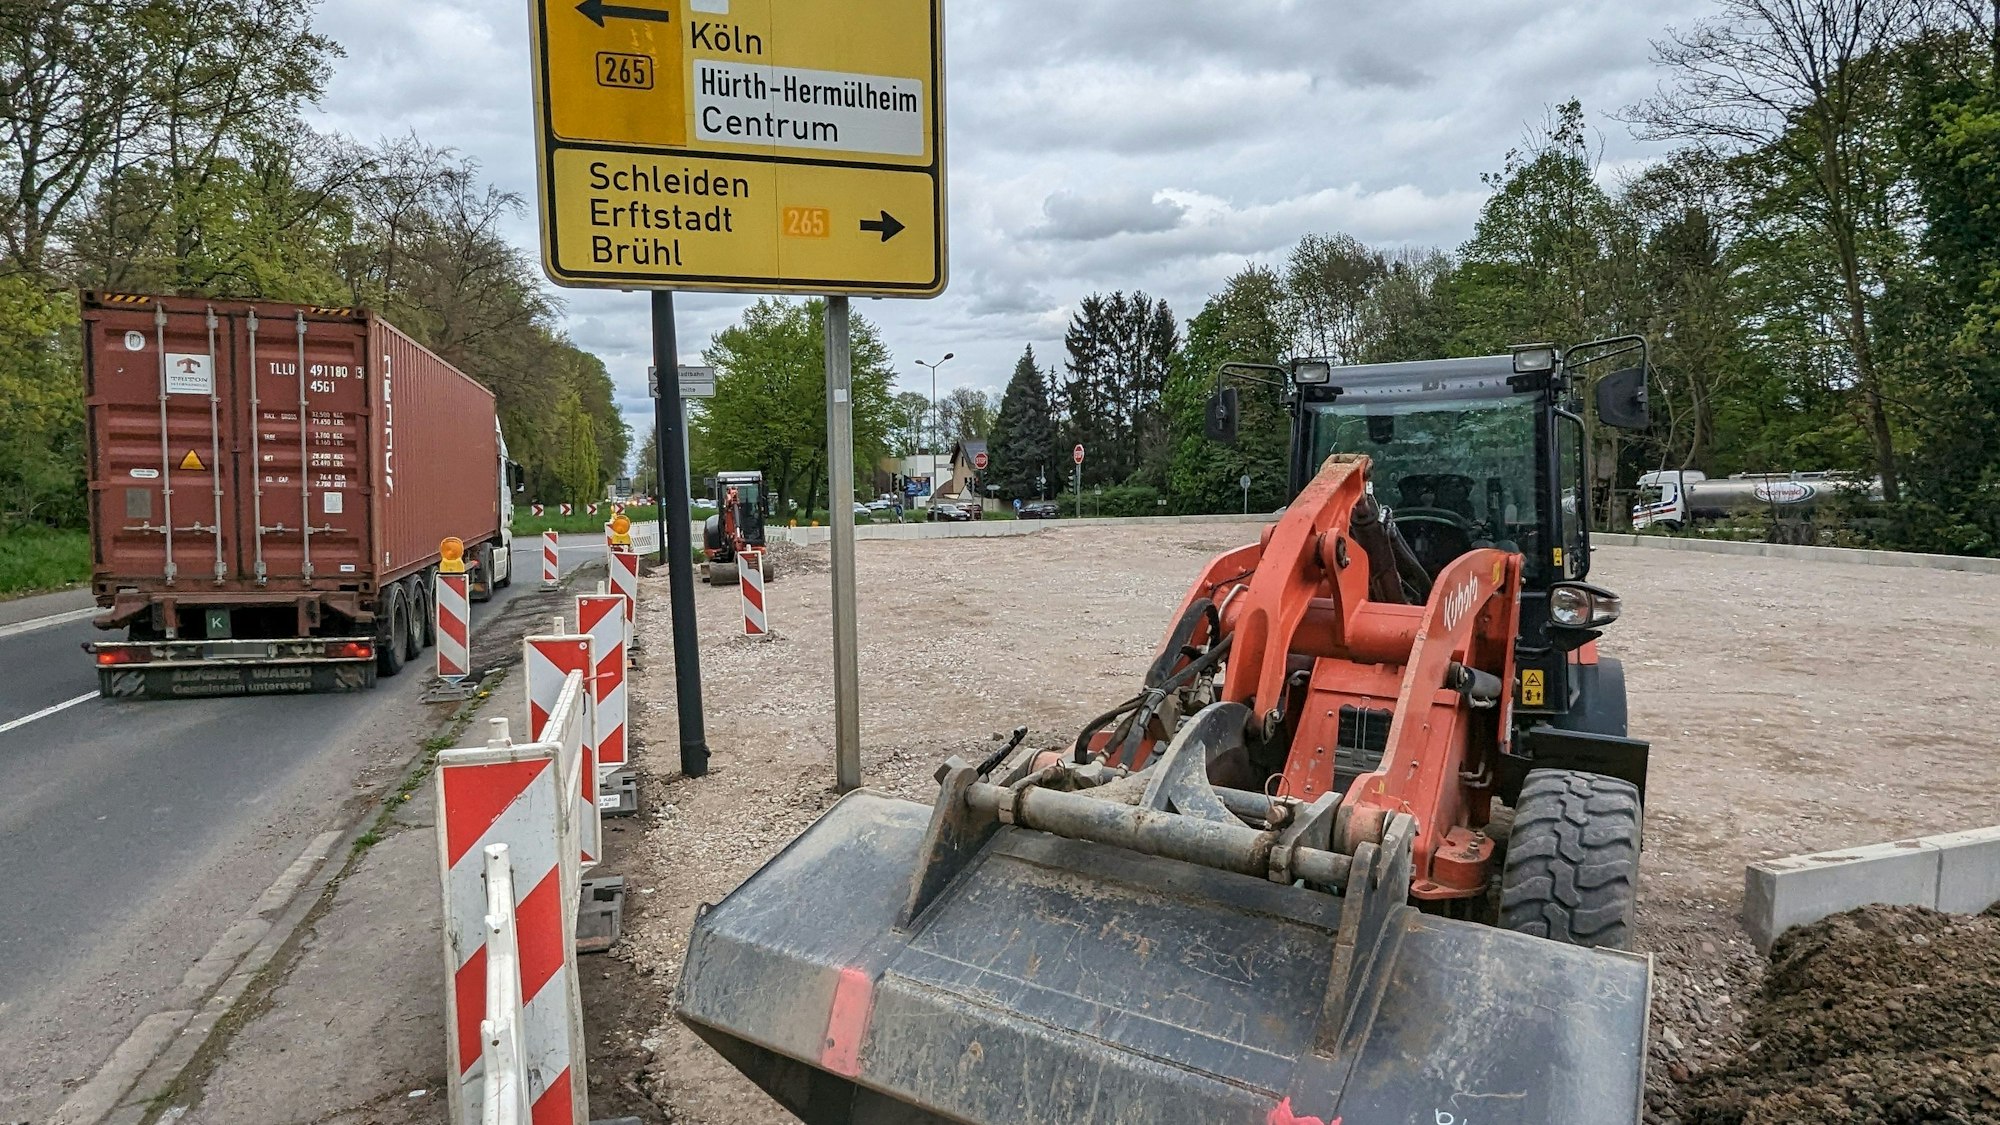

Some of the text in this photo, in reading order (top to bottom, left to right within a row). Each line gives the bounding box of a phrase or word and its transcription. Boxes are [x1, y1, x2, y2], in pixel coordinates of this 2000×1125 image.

[691, 21, 762, 55] Köln
[604, 57, 645, 85] 265
[701, 67, 918, 113] Hürth-Hermülheim
[702, 106, 839, 142] Centrum
[590, 161, 749, 198] Schleiden
[590, 198, 733, 233] Erftstadt
[787, 209, 825, 236] 265
[592, 235, 682, 266] Brühl
[270, 362, 295, 375] TLLU
[310, 364, 348, 378] 491180
[310, 380, 335, 393] 45G1
[1443, 570, 1478, 632] Kubota
[211, 617, 223, 628] K
